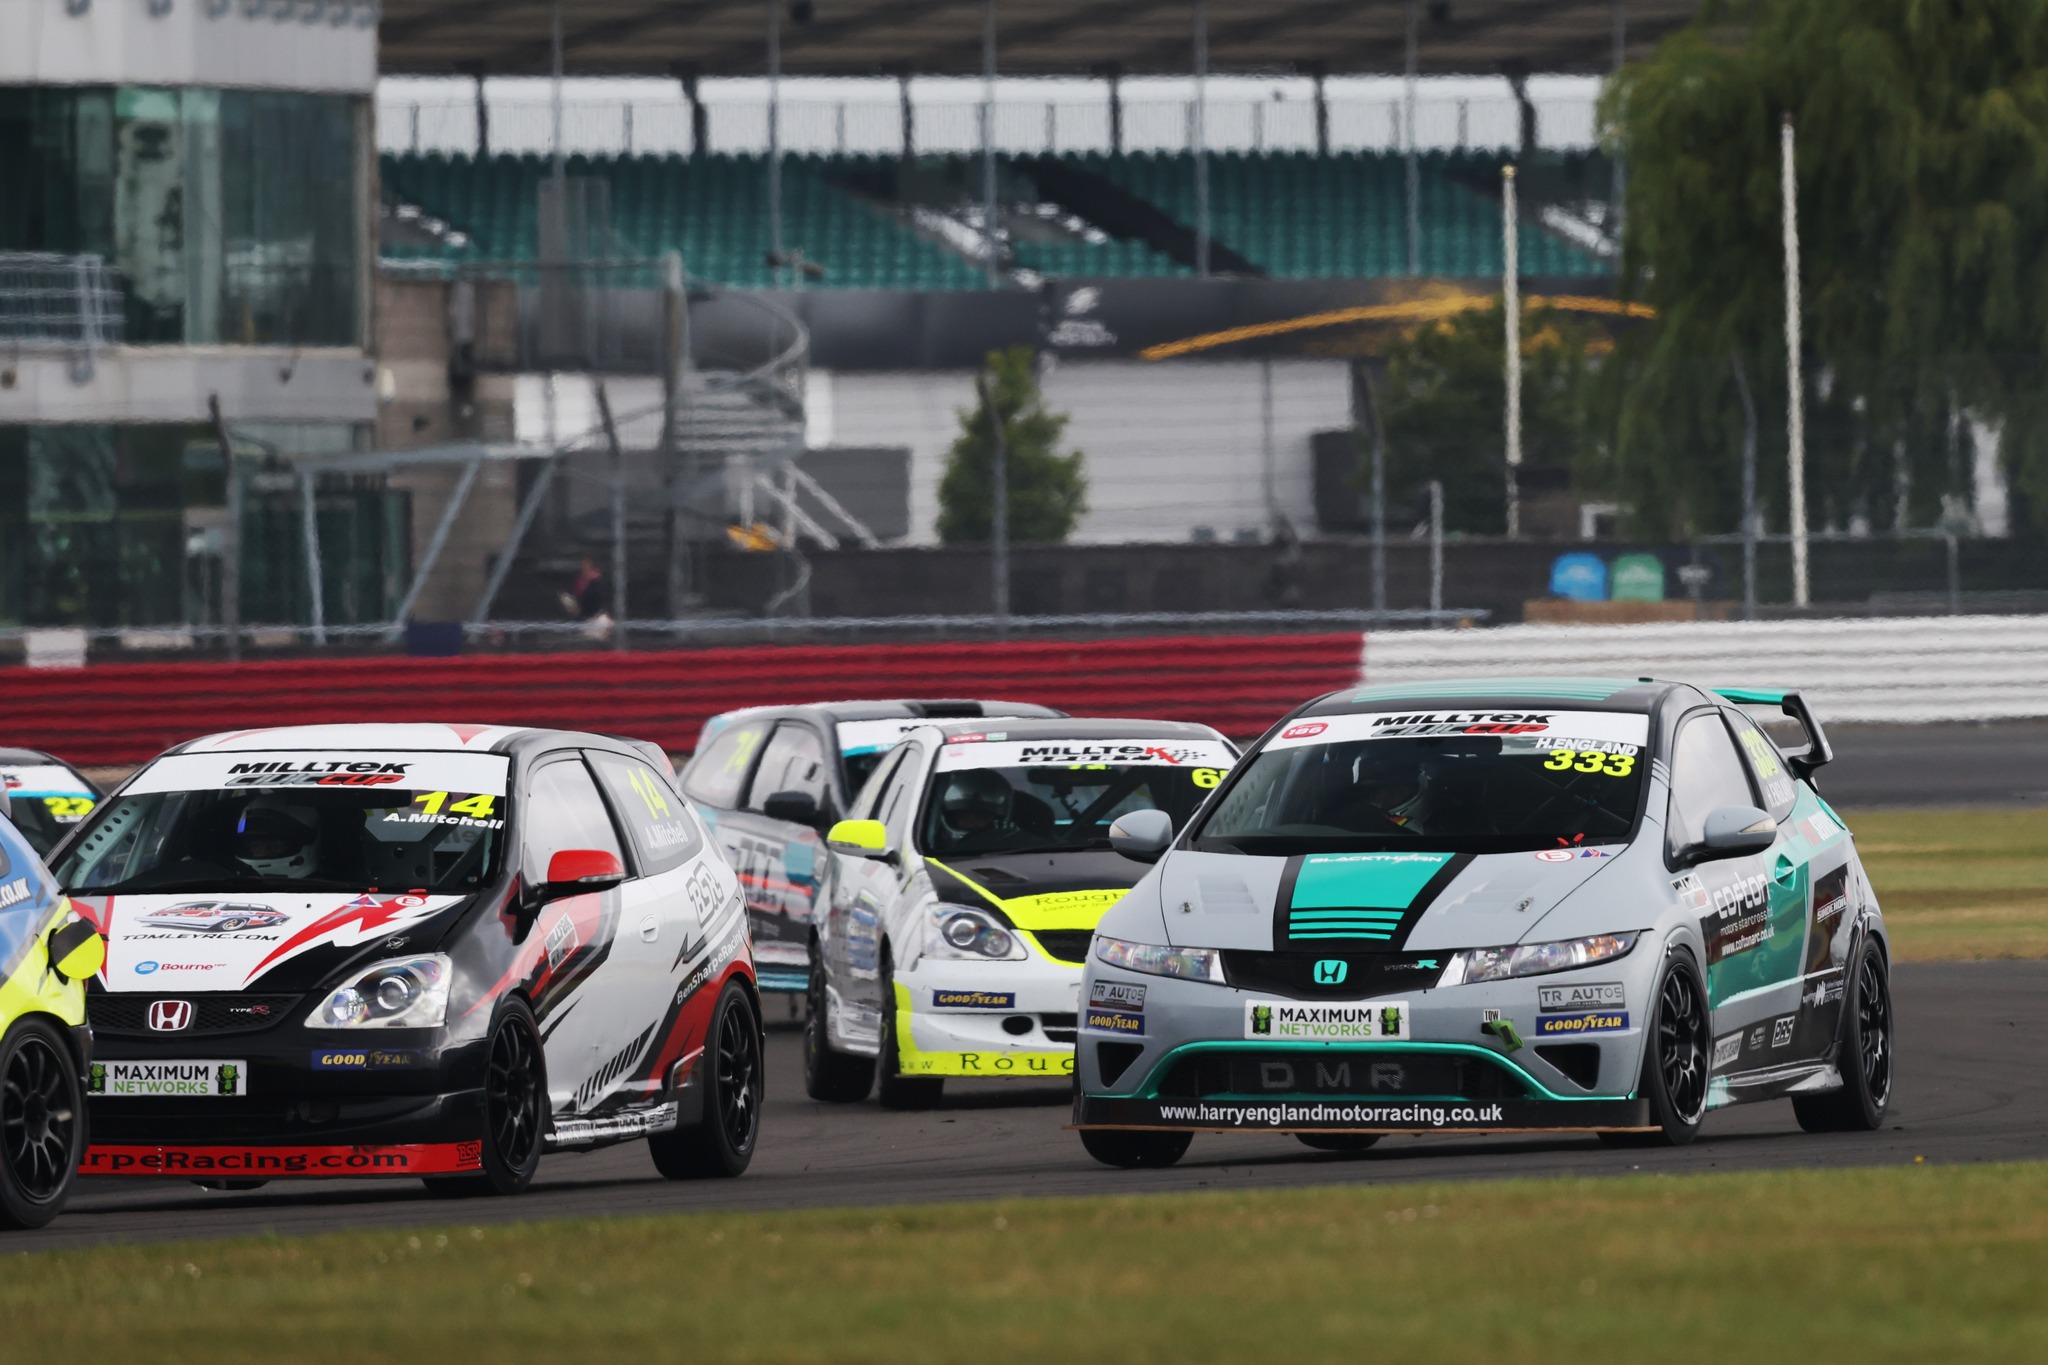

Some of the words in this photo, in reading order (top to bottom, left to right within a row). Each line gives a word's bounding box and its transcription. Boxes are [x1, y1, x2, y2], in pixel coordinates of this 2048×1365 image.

[1534, 737, 1640, 757] H.ENGLAND
[1543, 749, 1636, 777] 333
[626, 767, 671, 820] 14
[414, 790, 496, 818] 14
[383, 812, 504, 830] A.Mitchell
[122, 932, 281, 942] TOMLEYRC.COM
[161, 963, 214, 971] Bourne
[938, 991, 1008, 1006] GOODYEAR
[1541, 990, 1563, 1002] TR
[1571, 987, 1623, 1000] AUTOS
[1089, 1014, 1139, 1030] GOODYEAR
[1279, 1007, 1373, 1023] MAXIMUM
[1485, 1010, 1499, 1021] TOW
[1544, 1014, 1623, 1031] GOODYEAR
[1279, 1023, 1373, 1037] NETWORKS
[114, 1065, 209, 1080] MAXIMUM
[114, 1081, 209, 1094] NETWORKS
[1160, 1103, 1503, 1126] www.harryenglandmotorracing.co.uk
